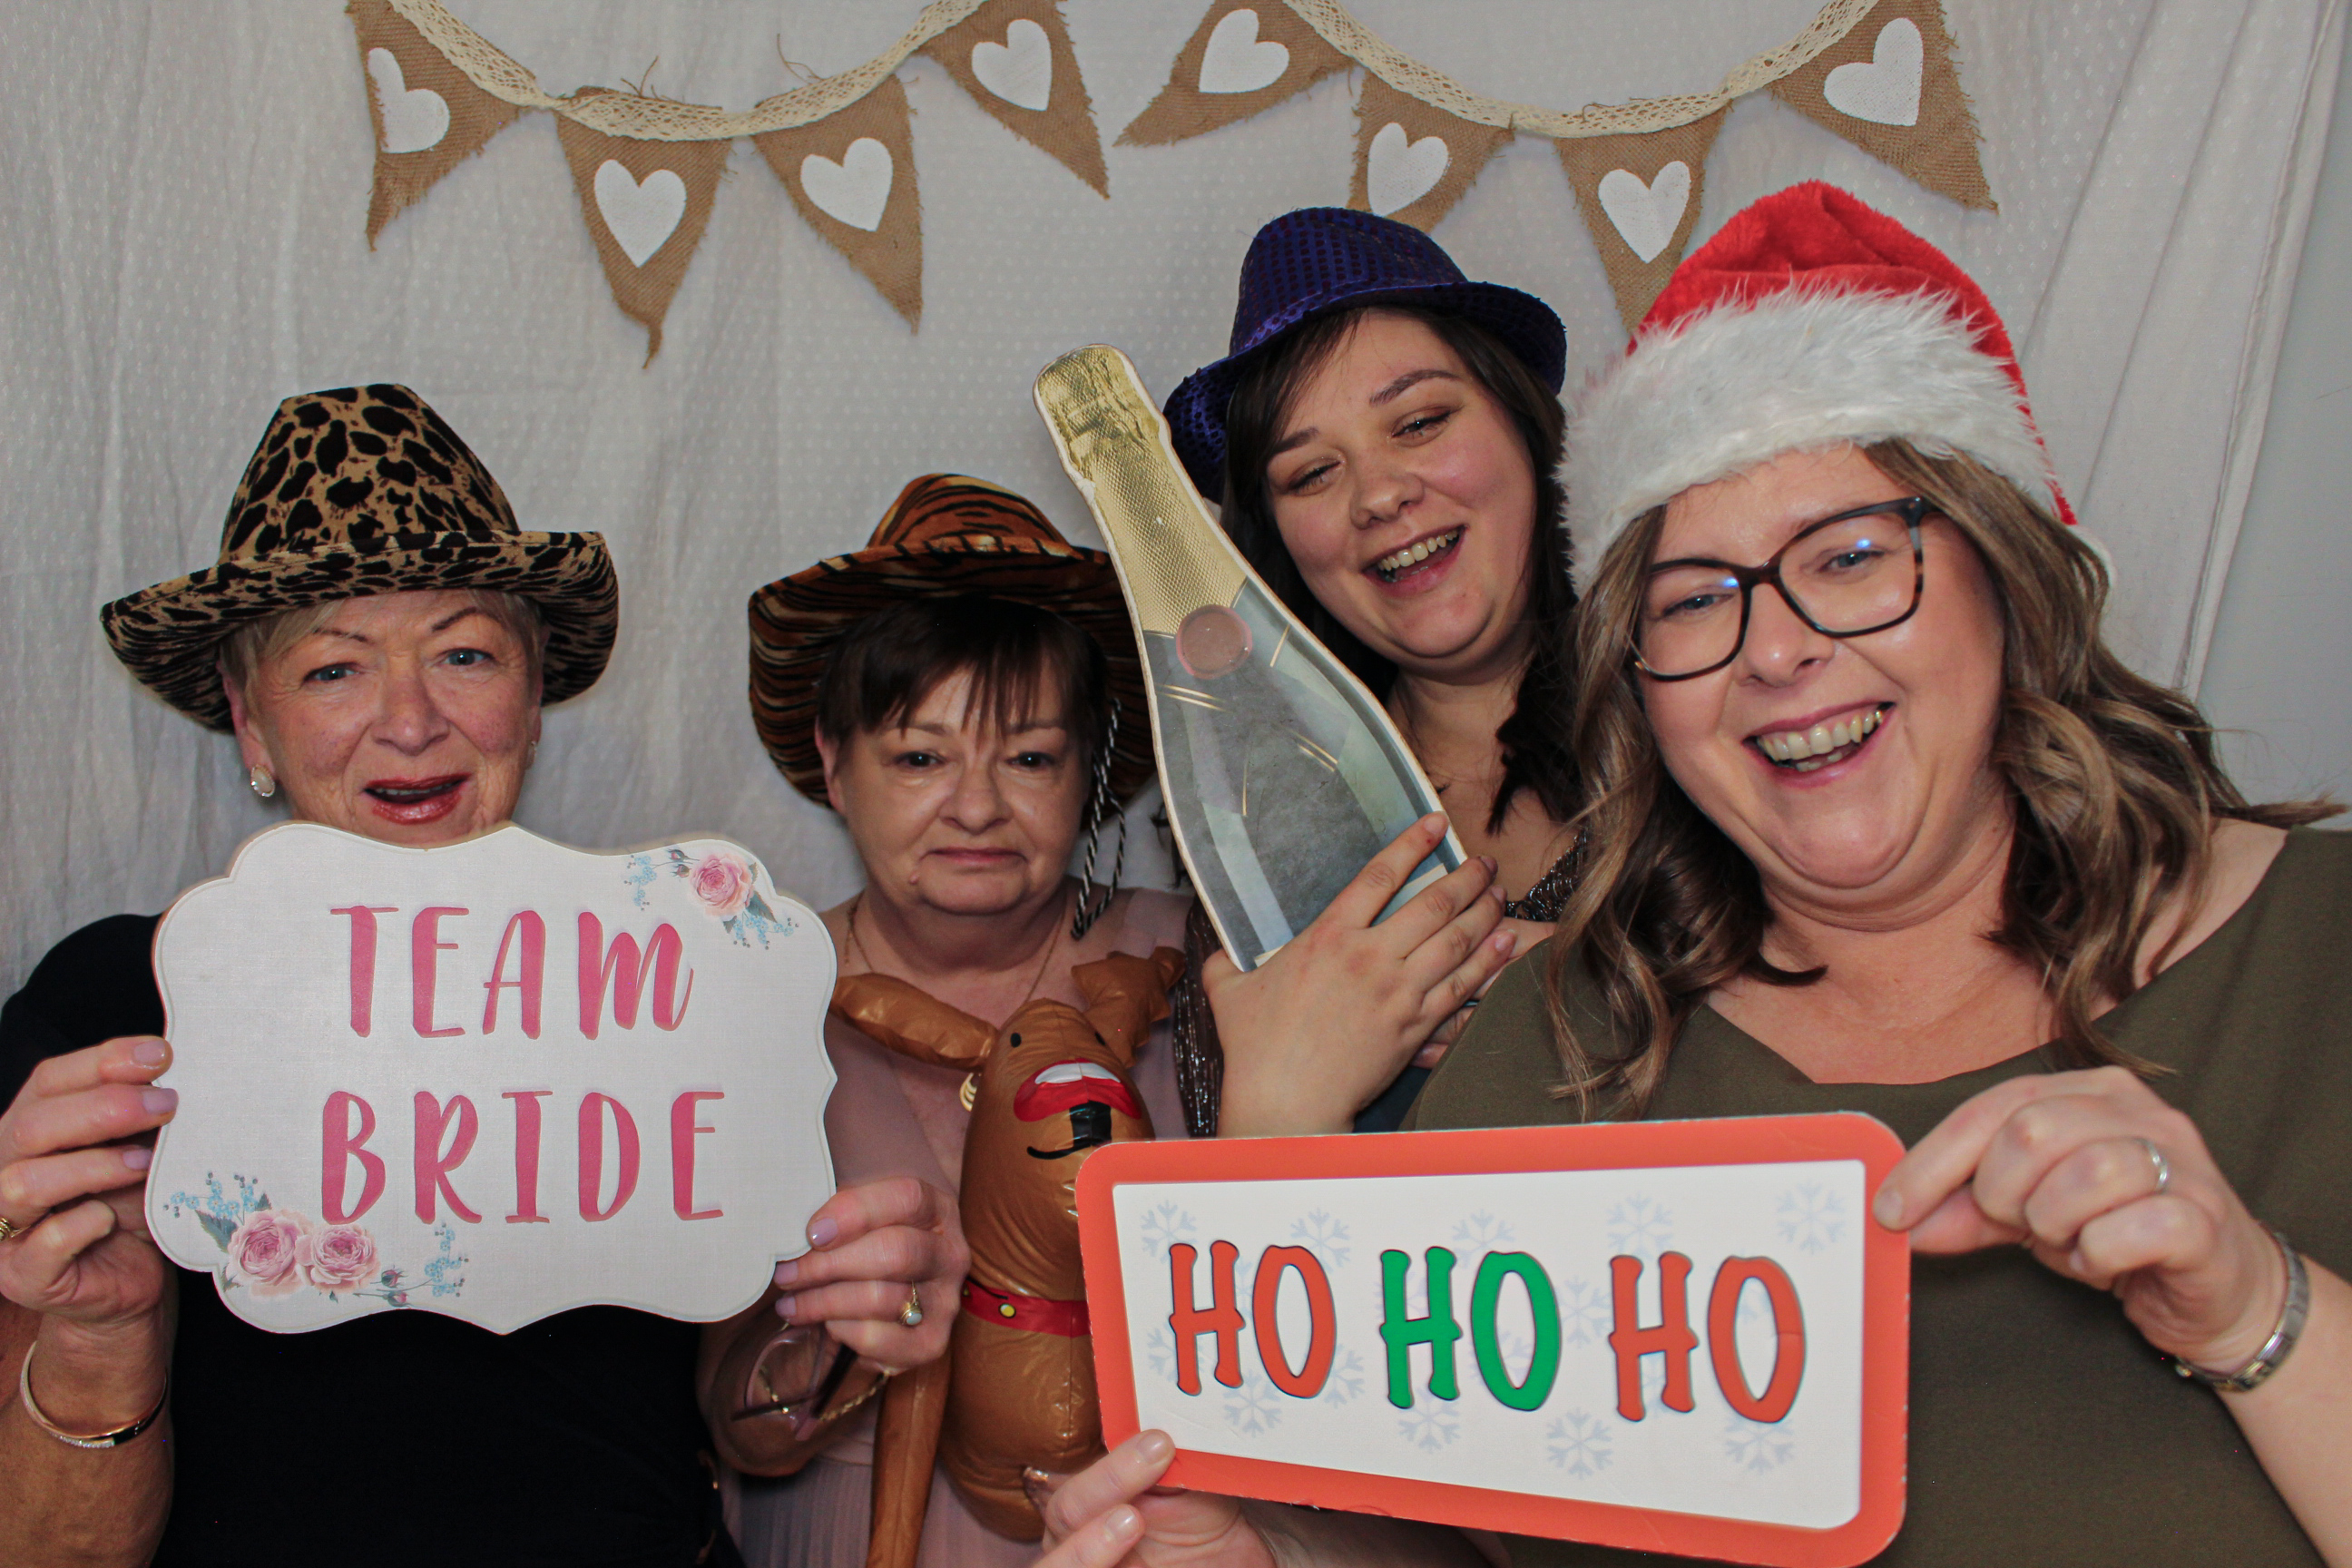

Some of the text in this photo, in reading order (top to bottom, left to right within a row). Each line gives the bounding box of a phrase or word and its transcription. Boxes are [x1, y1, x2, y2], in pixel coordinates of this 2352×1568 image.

[330, 905, 693, 1040] TEAM
[321, 1090, 725, 1224] BRIDE
[1169, 1240, 1807, 1423] HO HO HO
